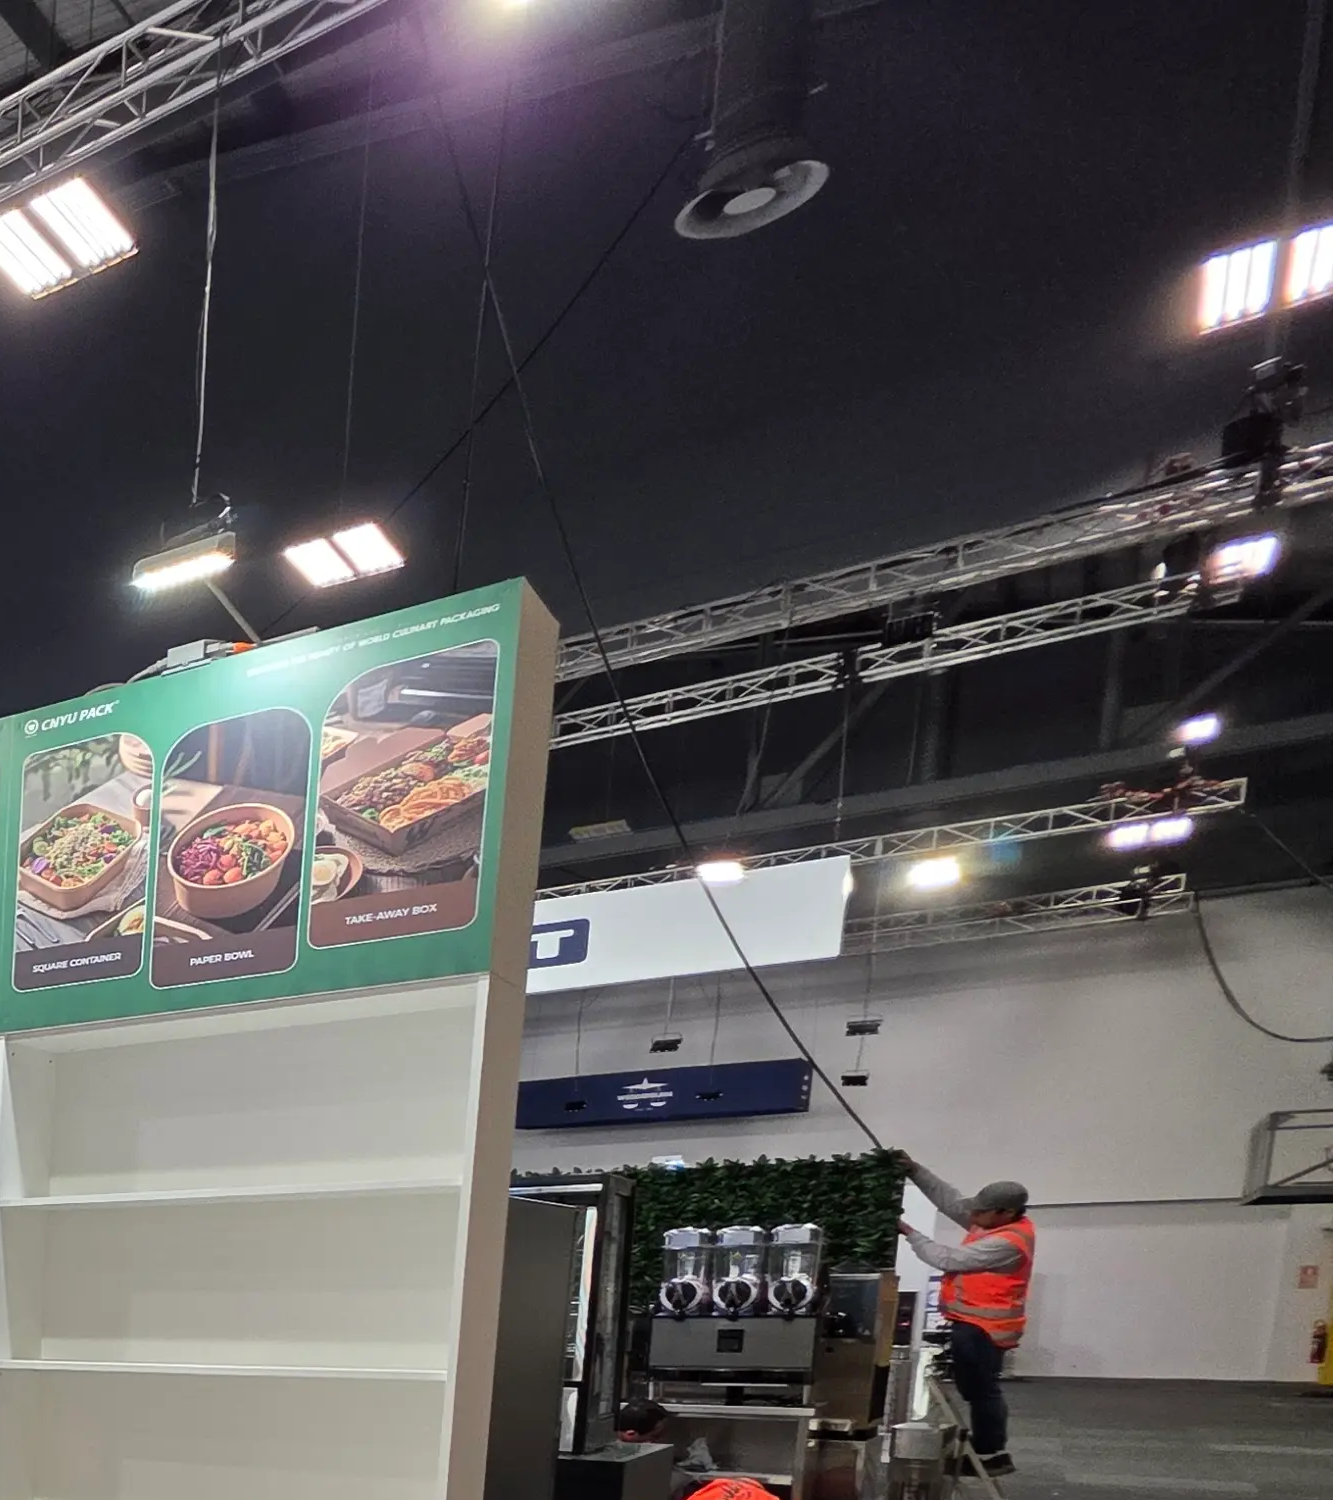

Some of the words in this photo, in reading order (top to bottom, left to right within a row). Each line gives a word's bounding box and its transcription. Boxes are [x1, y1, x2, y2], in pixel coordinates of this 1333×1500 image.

[439, 603, 501, 626] PACKAGING
[41, 711, 79, 731] CNYU
[79, 702, 115, 721] PACK
[345, 907, 410, 925] TAKE-AWAY
[411, 903, 438, 915] BOX
[32, 960, 68, 973] SQUARE
[69, 952, 122, 967] CONTAINER
[190, 954, 222, 966] PAPER
[224, 950, 255, 961] BOWL
